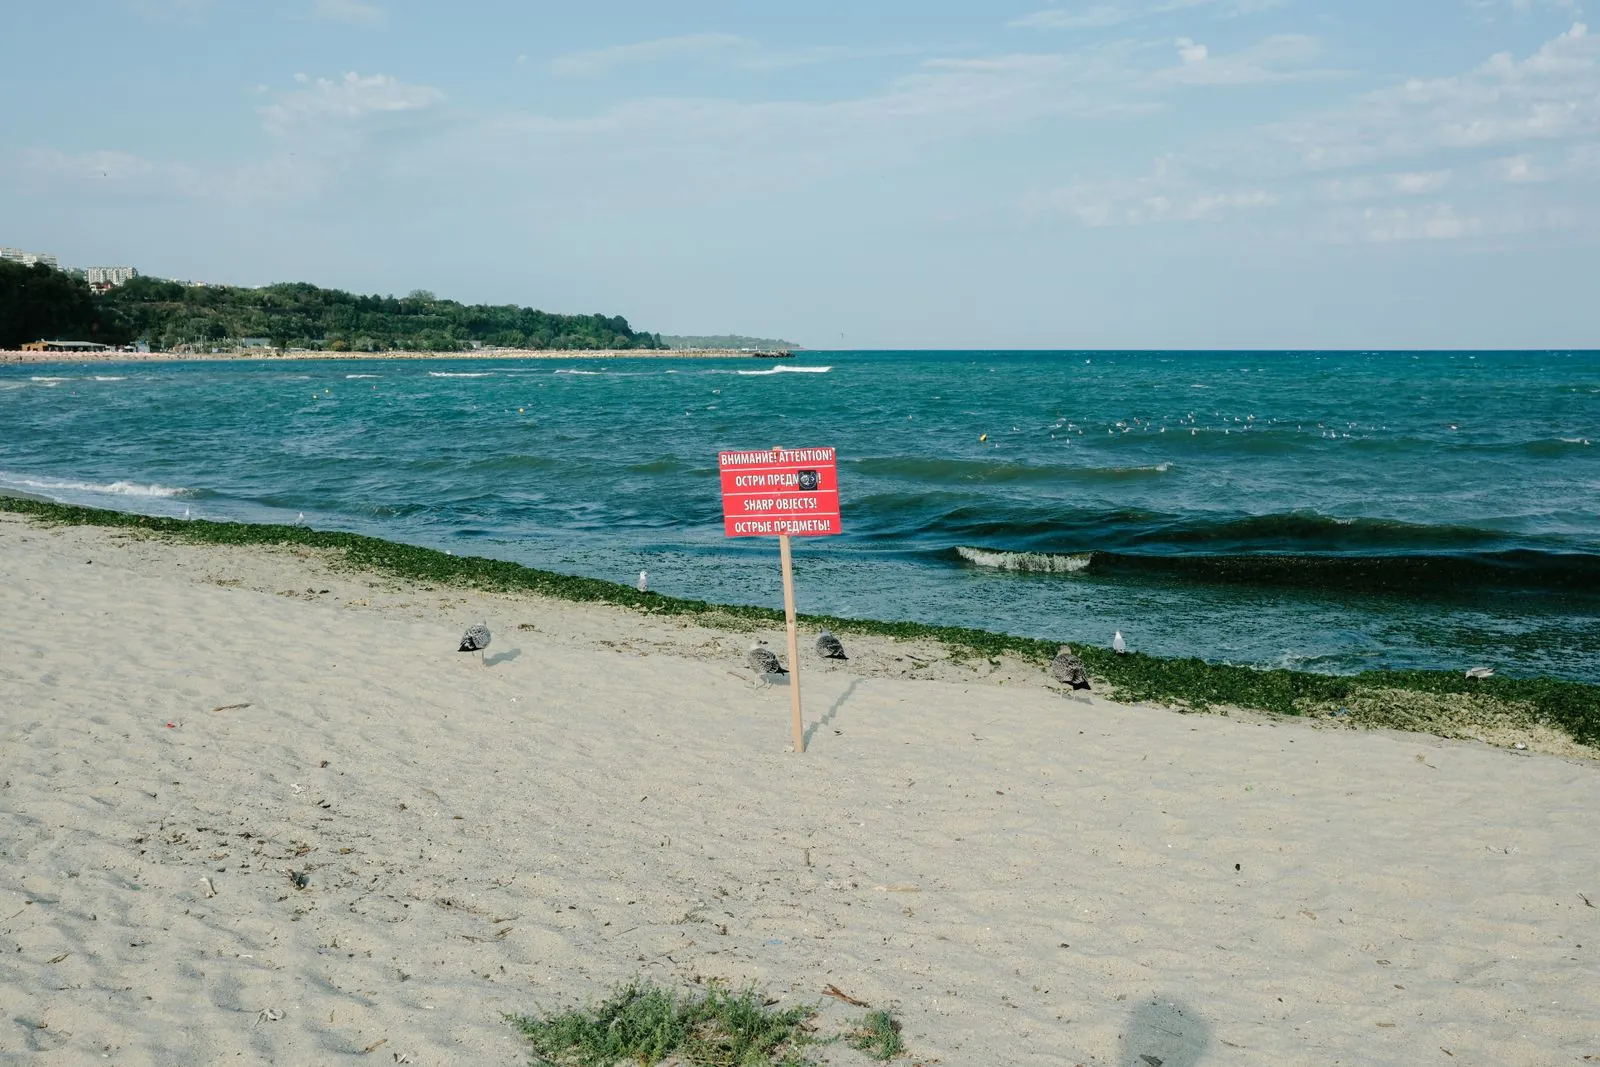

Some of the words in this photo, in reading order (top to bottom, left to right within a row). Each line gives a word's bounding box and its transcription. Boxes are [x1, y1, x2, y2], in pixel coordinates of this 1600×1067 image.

[721, 452, 777, 465] ВНИМАНИЕ!
[779, 449, 832, 462] ATTENTION!
[735, 475, 765, 487] ОСТРИ
[744, 499, 774, 511] SHARP
[776, 498, 817, 510] OBJECTS!
[735, 521, 772, 533] ОСТРЫЕ
[774, 520, 830, 533] ПРЕДМЕТЫ!
